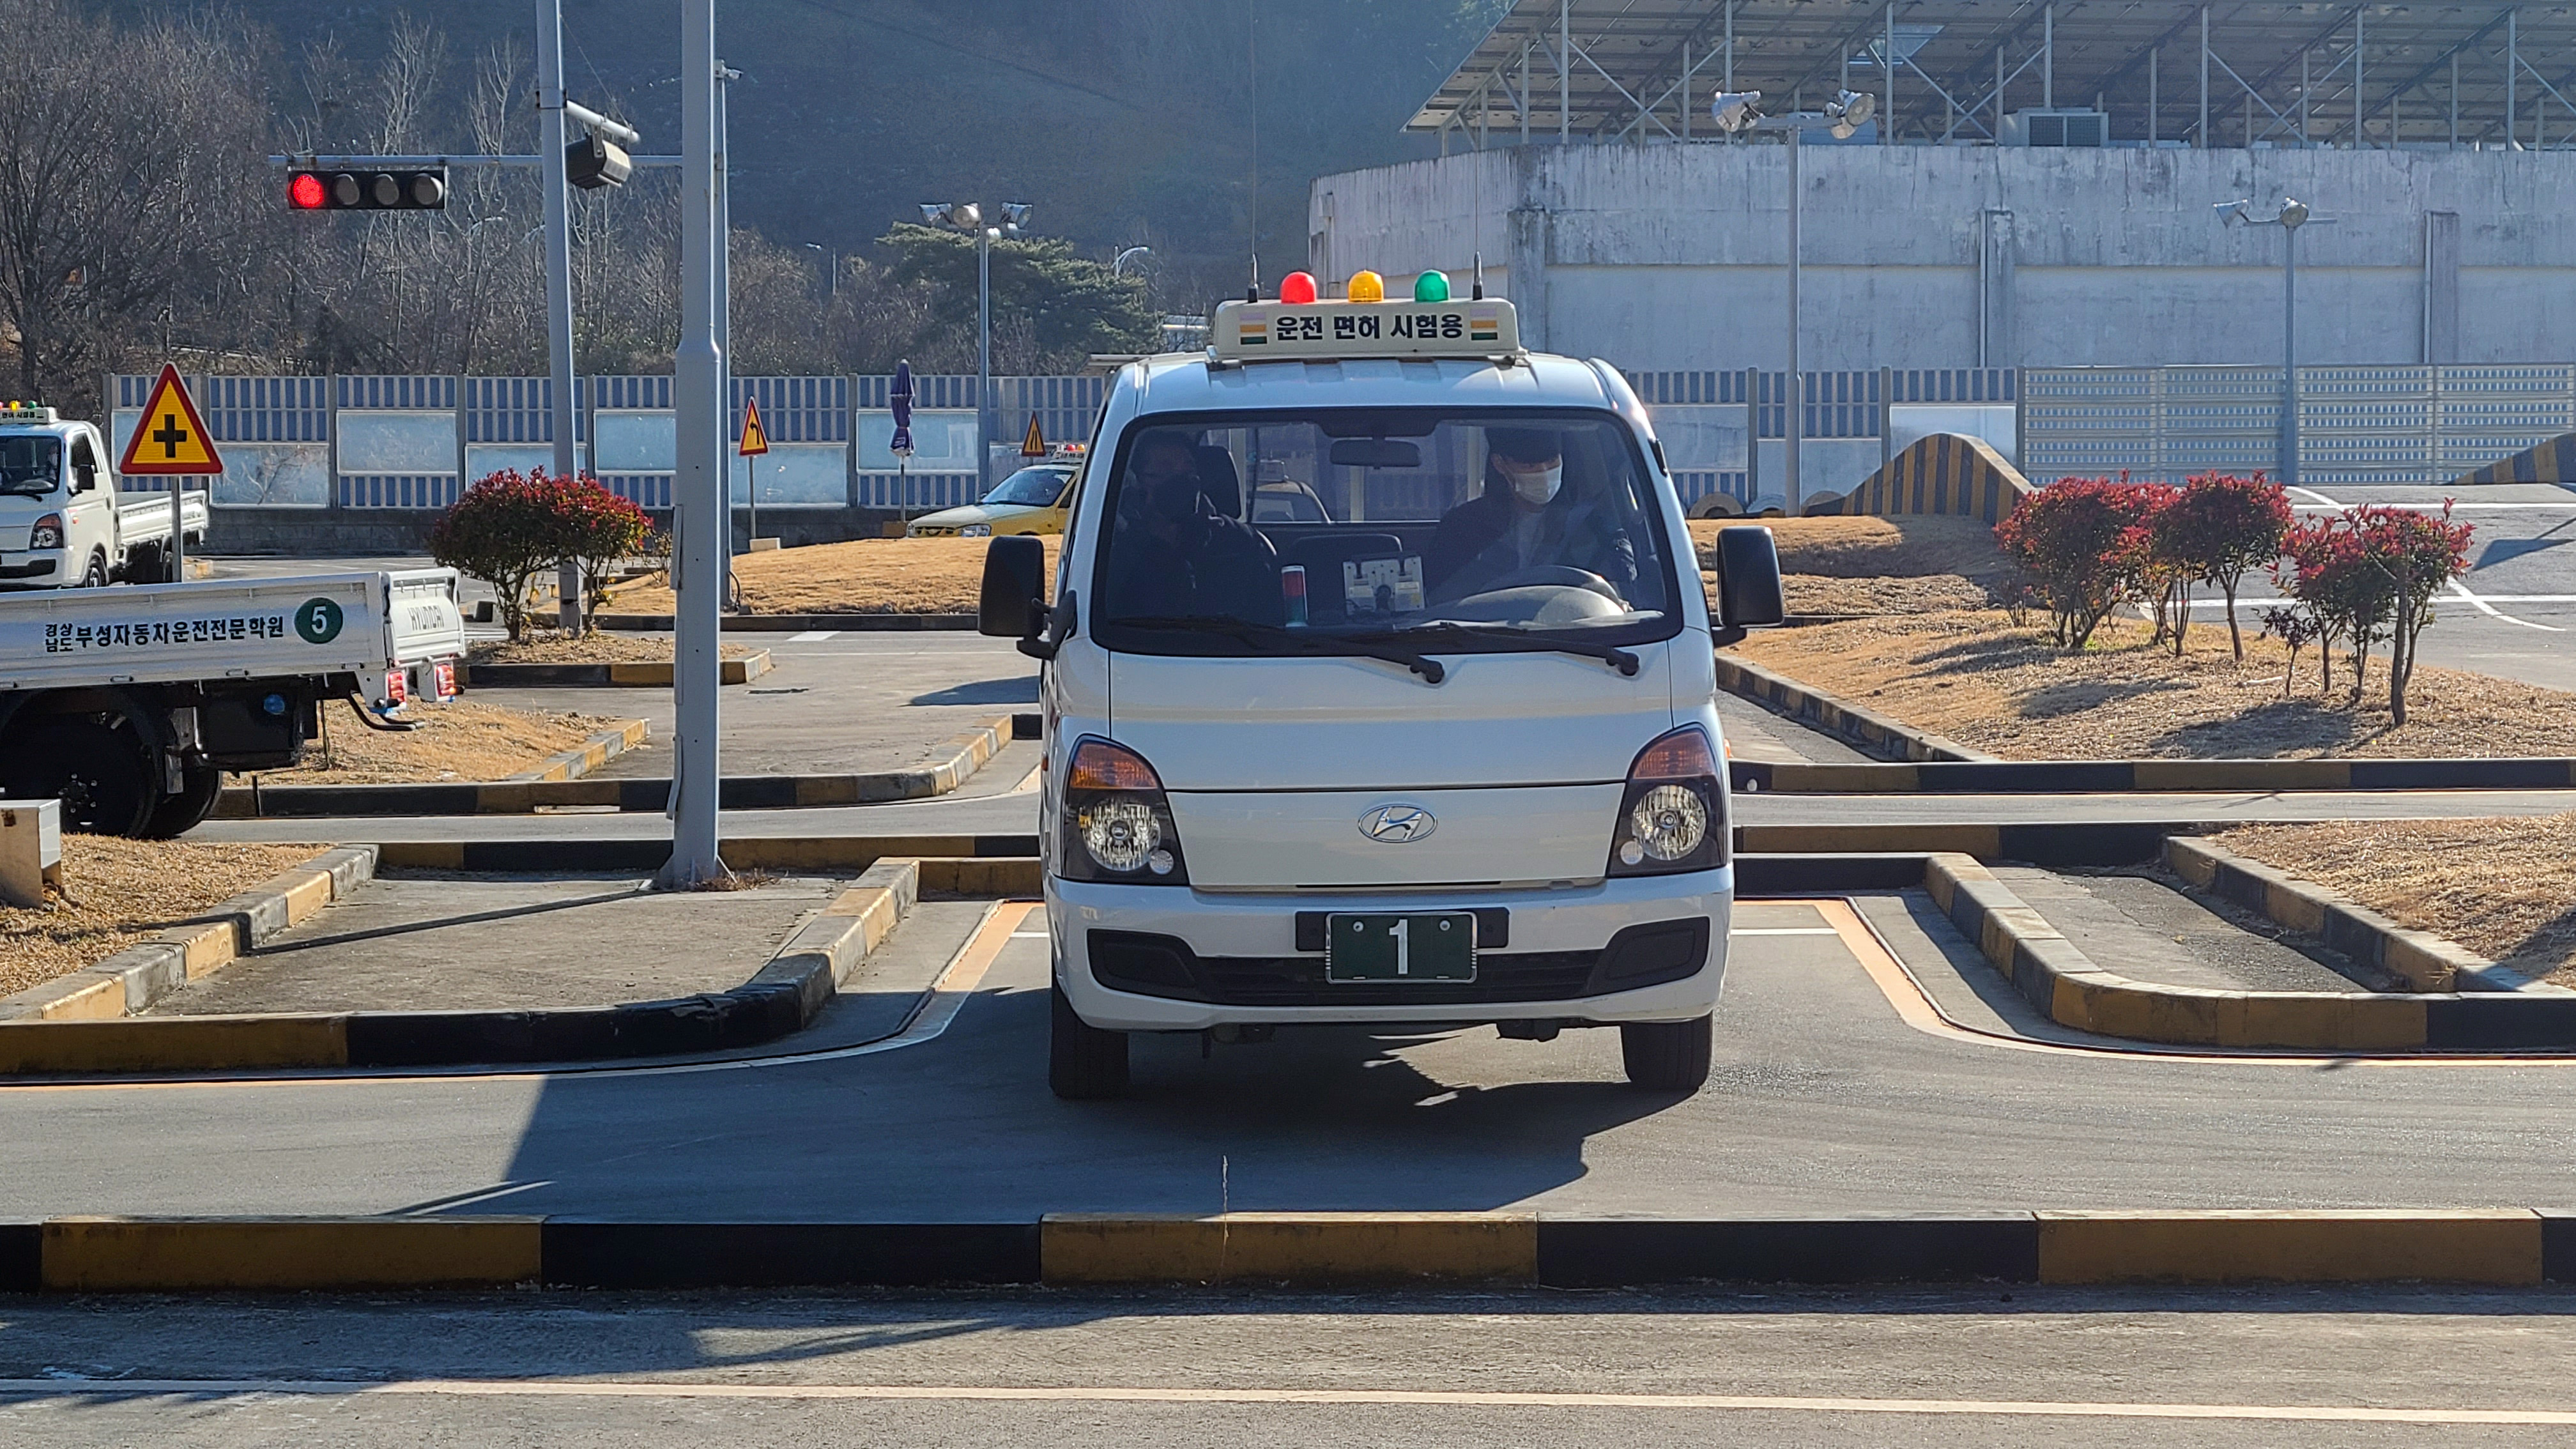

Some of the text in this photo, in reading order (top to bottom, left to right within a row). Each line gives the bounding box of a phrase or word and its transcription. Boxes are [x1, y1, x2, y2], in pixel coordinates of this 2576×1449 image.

[1276, 314, 1463, 341] 운전 면허 시험용
[45, 623, 73, 637] 경상
[75, 615, 284, 648] 부성자동차운전전문학원
[310, 606, 328, 633] 5
[407, 605, 444, 631] HYUNDAI
[45, 638, 73, 653] 남도
[1388, 919, 1408, 974] 1
